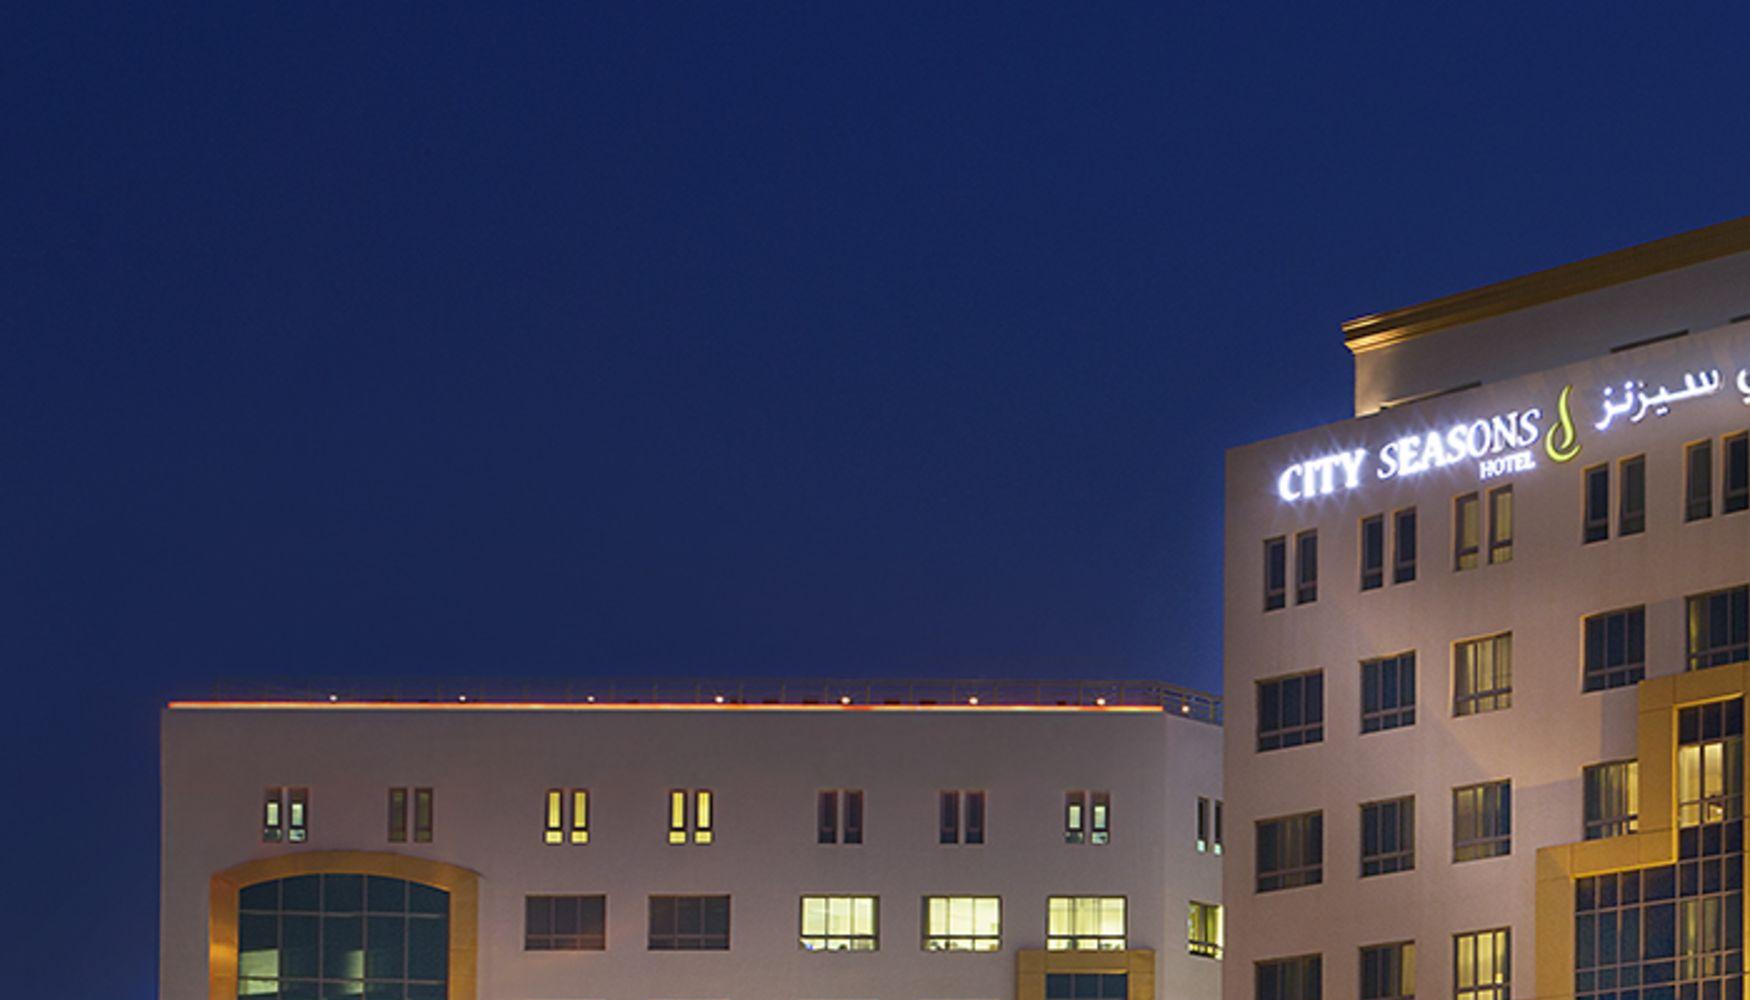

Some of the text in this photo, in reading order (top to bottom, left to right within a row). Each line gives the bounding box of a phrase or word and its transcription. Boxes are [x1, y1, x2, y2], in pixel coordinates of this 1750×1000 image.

[1594, 368, 1720, 431] سيزنز
[1277, 407, 1541, 502] CITY SEASONS
[1479, 449, 1537, 480] HOTEL
